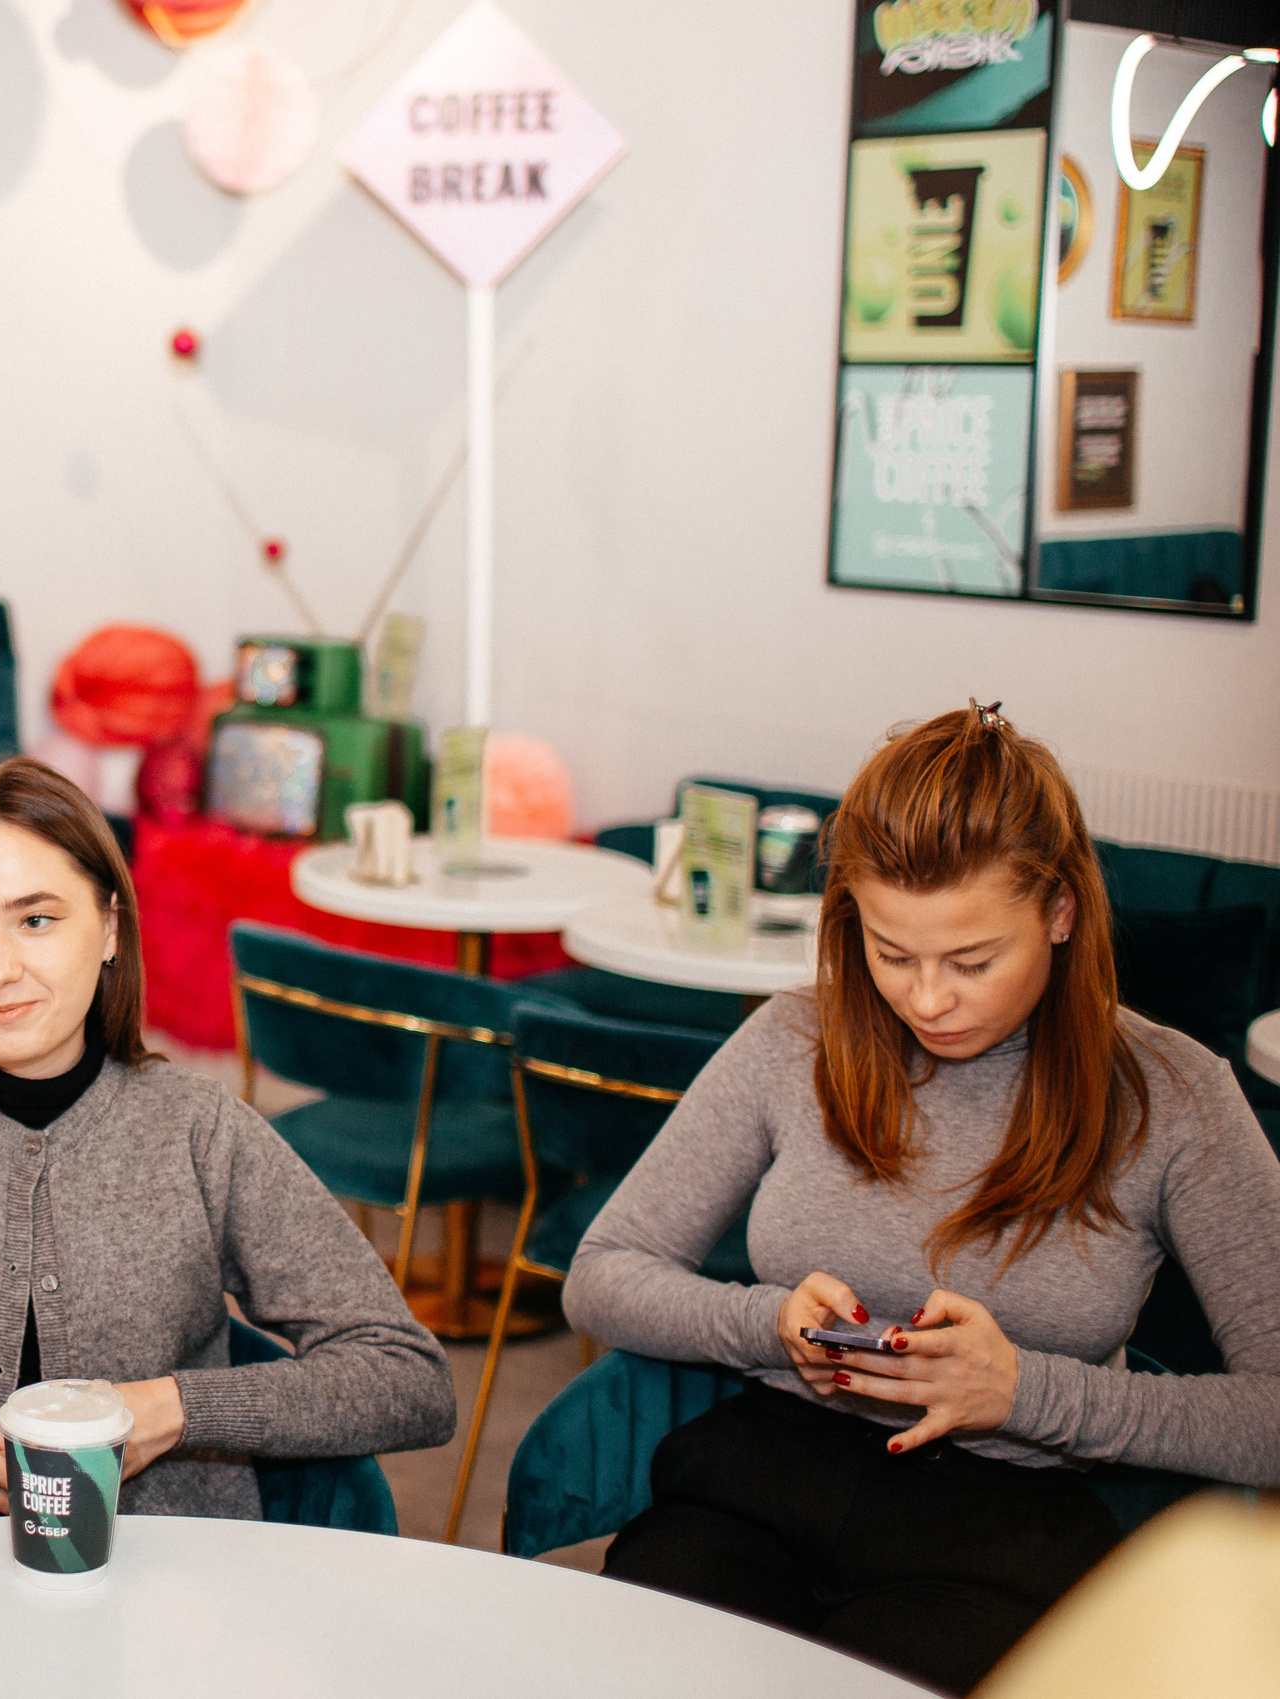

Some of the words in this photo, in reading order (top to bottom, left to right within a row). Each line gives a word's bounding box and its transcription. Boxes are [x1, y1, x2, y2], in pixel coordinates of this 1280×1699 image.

[408, 89, 557, 134] COFFEE
[409, 161, 548, 204] BREAK
[30, 1473, 72, 1496] PRICE
[23, 1491, 72, 1516] COFFEE
[38, 1526, 69, 1537] СБЕР
